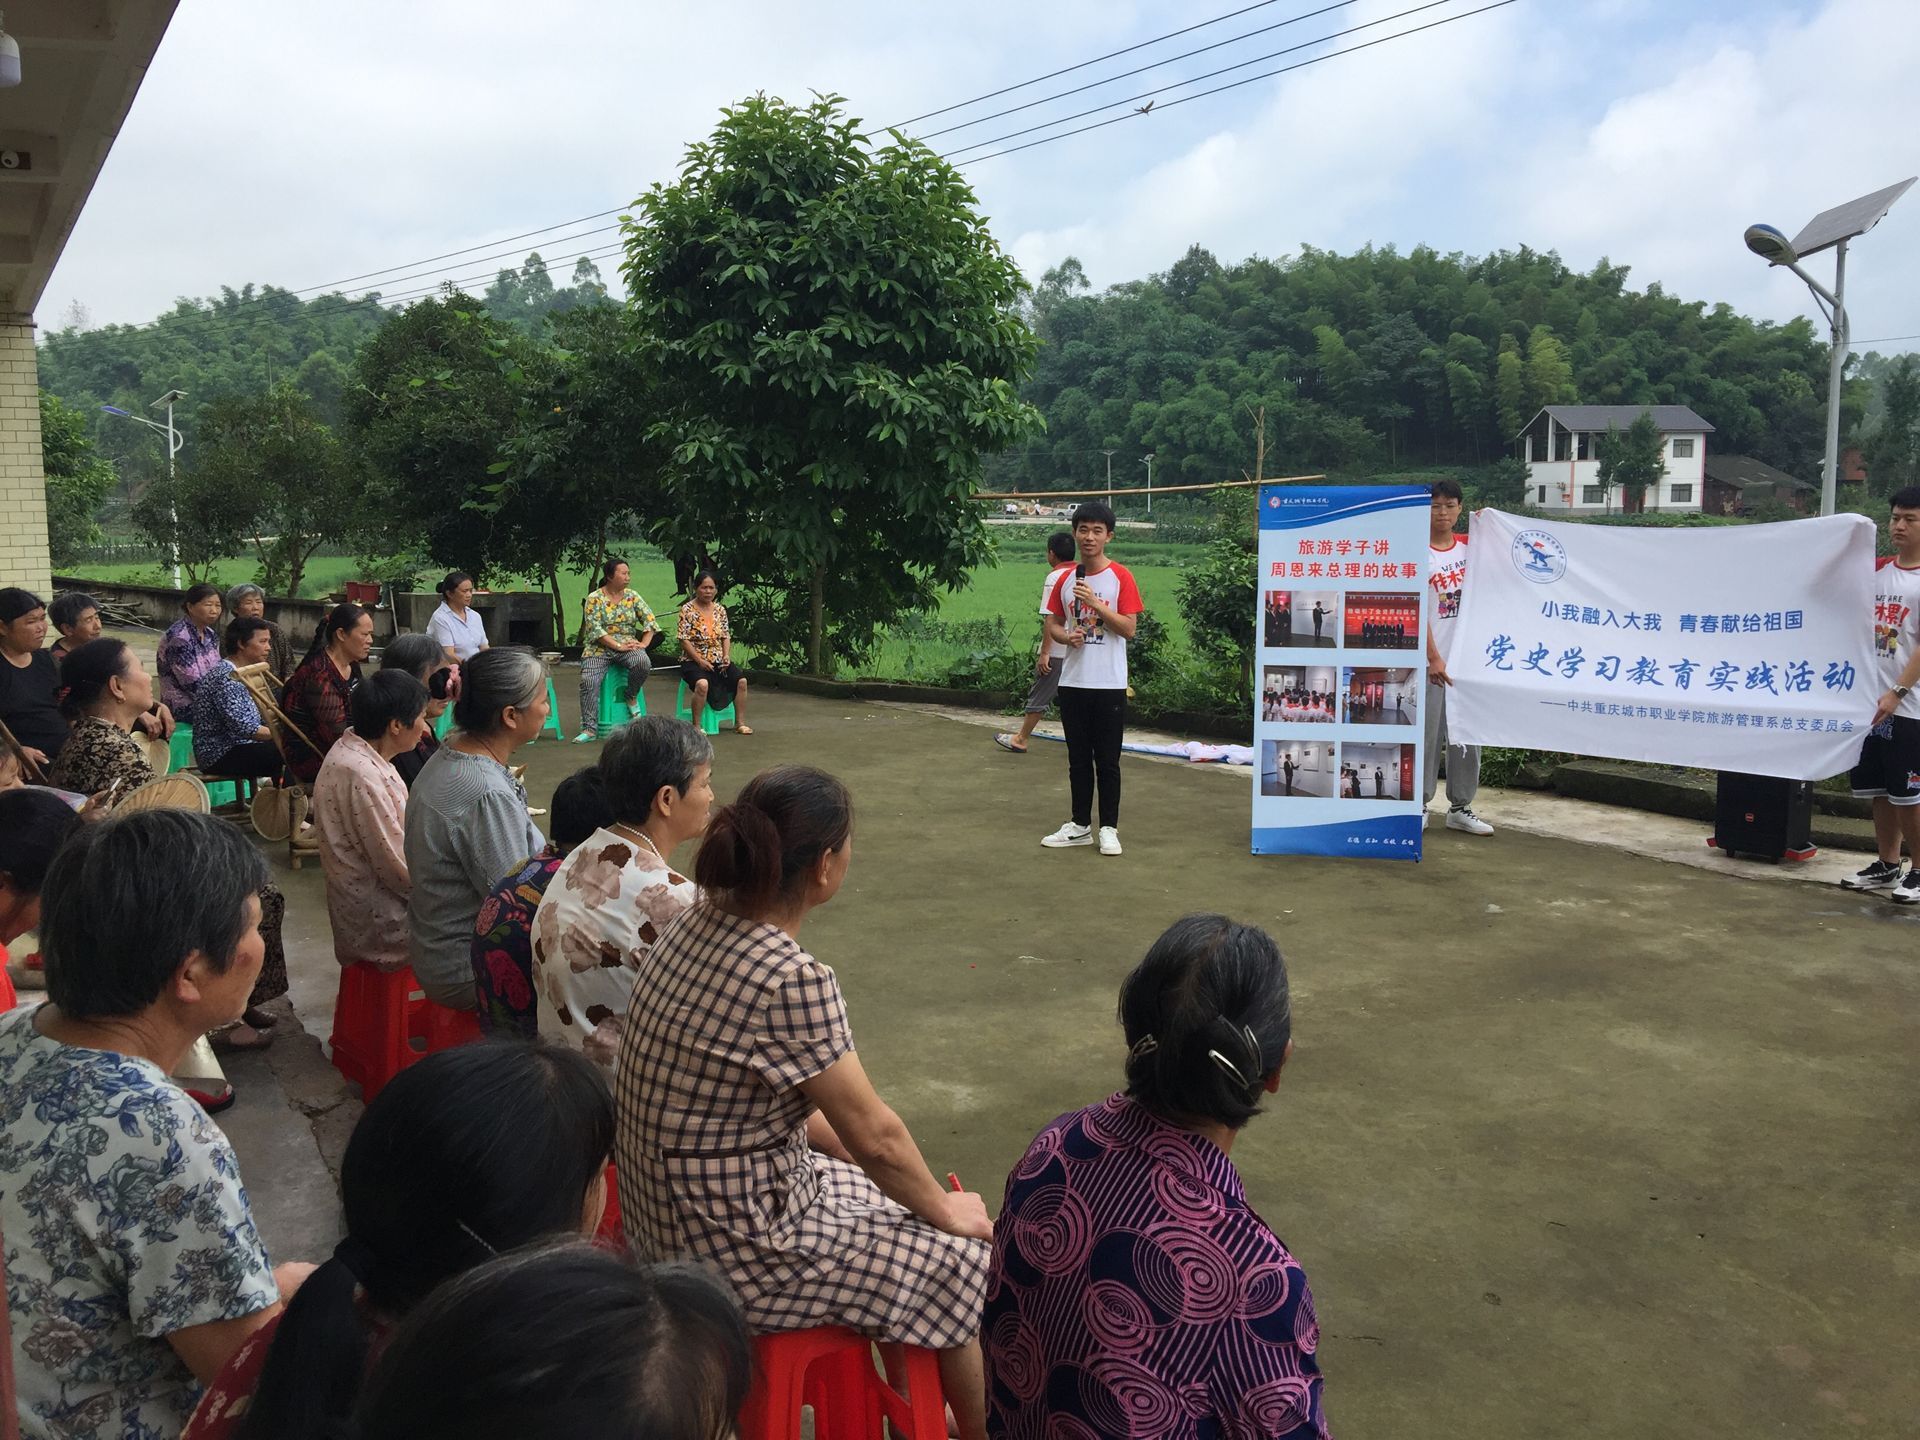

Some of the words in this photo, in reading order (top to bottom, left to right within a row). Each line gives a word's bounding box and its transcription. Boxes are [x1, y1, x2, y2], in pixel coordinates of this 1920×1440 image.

[1298, 539, 1389, 556] 旅游学子讲
[1270, 561, 1417, 579] 周恩来总理的故事
[1541, 600, 1663, 632] 小我融入大我
[1679, 609, 1803, 633] 青春献给祖国
[1484, 634, 1856, 696] 党史学习教育实践活动
